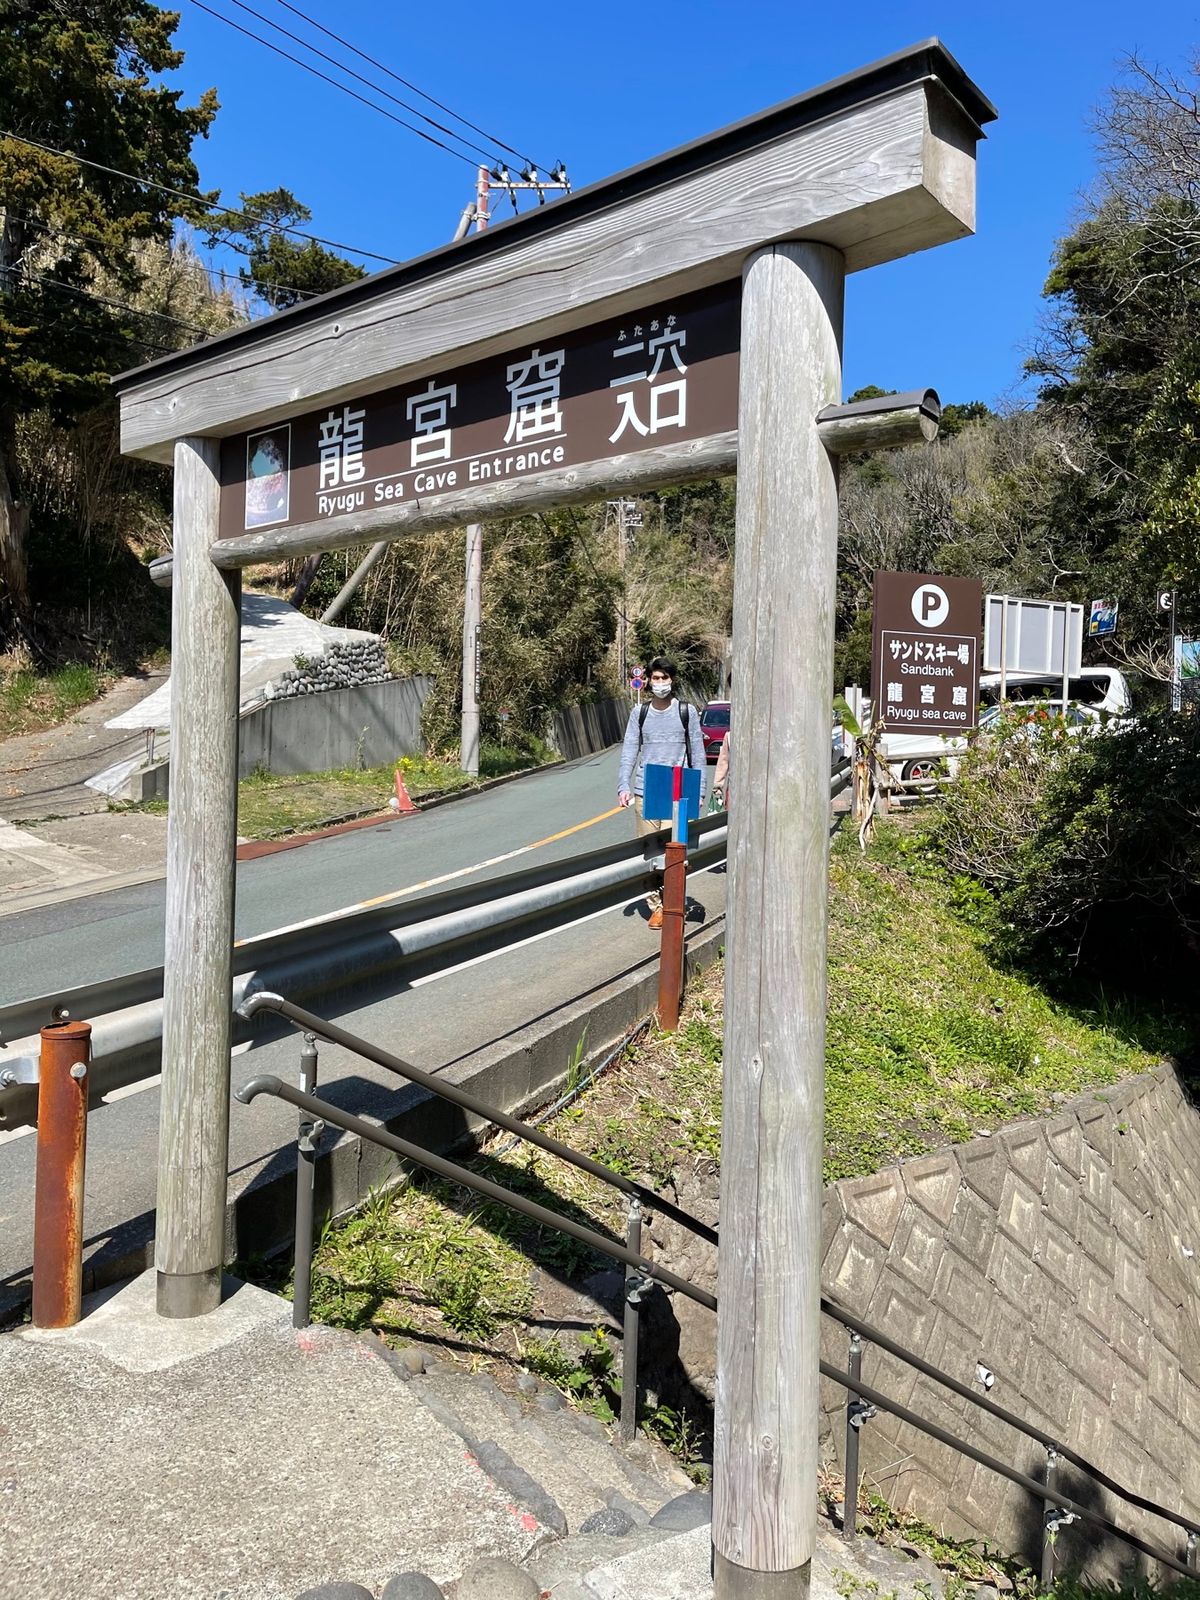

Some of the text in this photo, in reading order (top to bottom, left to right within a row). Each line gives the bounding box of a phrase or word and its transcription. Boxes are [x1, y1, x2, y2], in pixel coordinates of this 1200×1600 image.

[617, 315, 677, 341] ふたあな
[610, 327, 688, 388] 二穴
[318, 348, 566, 489] 龍宮窟
[608, 378, 687, 444] 入口
[318, 446, 565, 516] Ryugu Sea Cave Entrance
[922, 591, 942, 621] P
[889, 639, 970, 665] サンドスキー場
[901, 662, 955, 677] Sandbank
[887, 705, 967, 721] Ryugu sea cave
